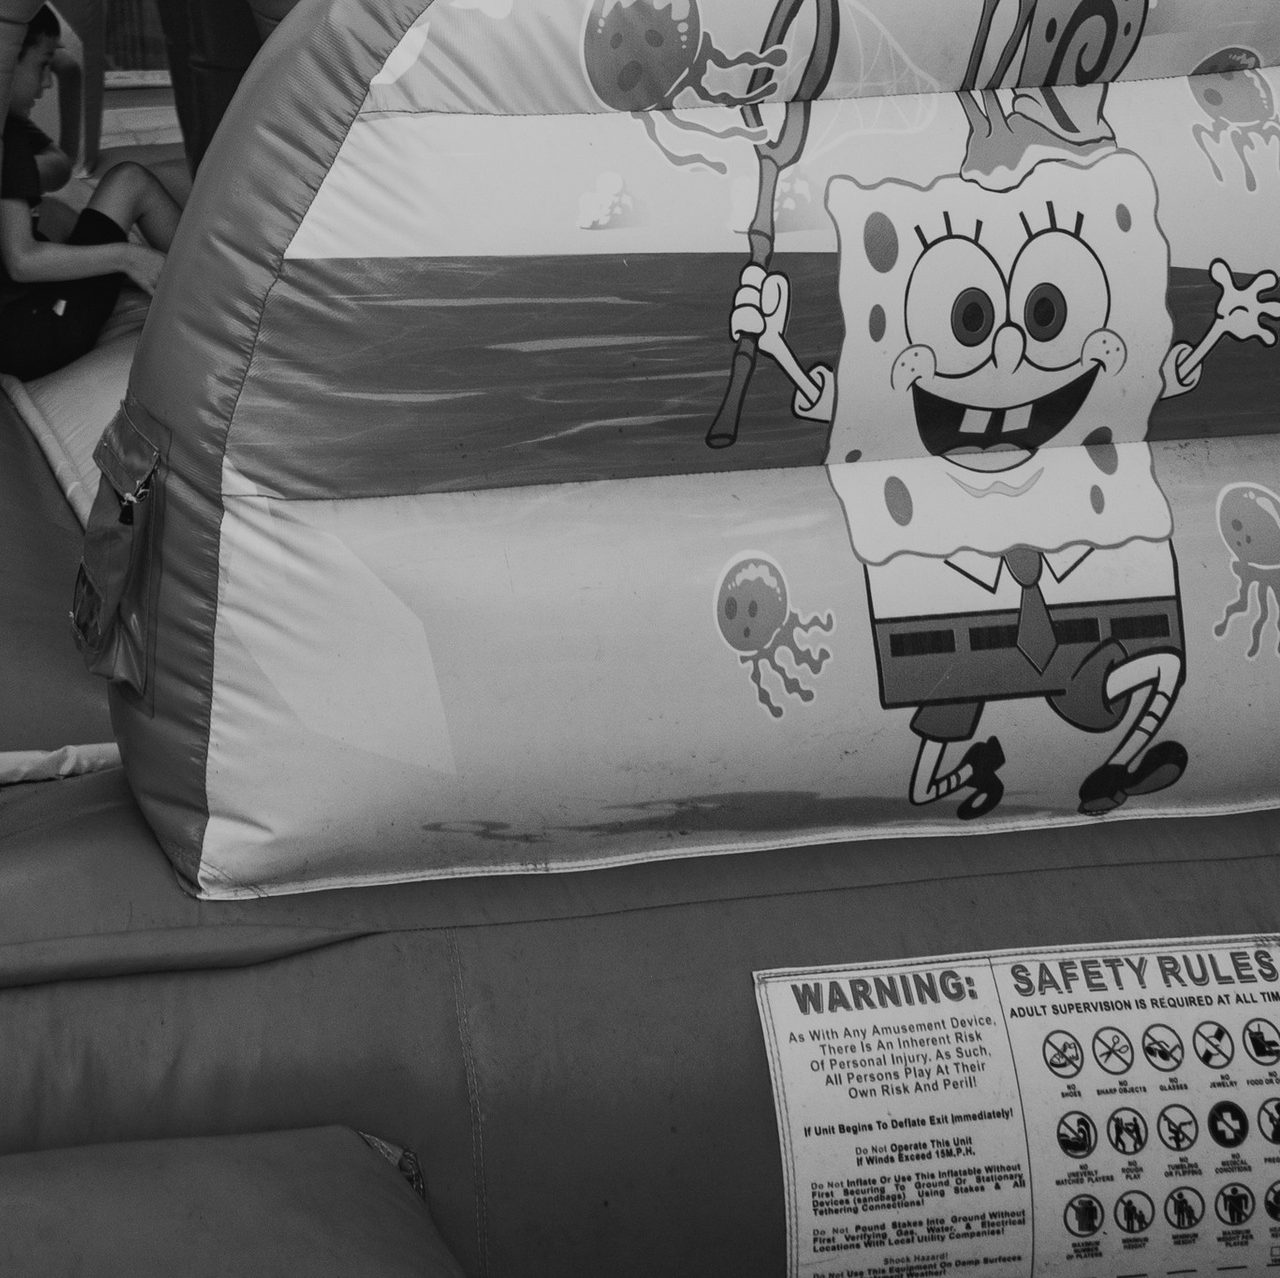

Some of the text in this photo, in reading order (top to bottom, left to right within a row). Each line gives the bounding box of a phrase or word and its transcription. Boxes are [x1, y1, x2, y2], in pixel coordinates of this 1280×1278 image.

[1010, 950, 1279, 996] SAFETY RULES
[791, 970, 978, 1015] WARNING:
[1010, 991, 1280, 1019] ADULT SUPERVISION IS REQUIRED AT ALL TIM
[789, 1032, 805, 1044] As
[809, 1029, 839, 1041] With
[843, 1026, 867, 1039] Any
[872, 1019, 946, 1036] Amusement
[820, 1031, 983, 1056] There Is An Inherent Risk
[810, 1059, 825, 1072] Of
[830, 1054, 887, 1070] Personal
[936, 1049, 951, 1060] As
[956, 1045, 991, 1058] Such,
[825, 1061, 986, 1086] All Persons Play At Their
[849, 1076, 977, 1099] Own Risk And Peril!
[804, 1108, 1013, 1137] If Unit Begins To Deflate Exit Immediately!
[855, 1137, 972, 1155] Do Not Operate This Unit
[857, 1157, 864, 1166] If
[866, 1154, 895, 1165] Winds
[898, 1151, 932, 1162] Exceed
[811, 1163, 1021, 1191] Do Not Inflate Or Use This Inflatable Without
[812, 1173, 1023, 1199] First Securing To Ground Or Stationary
[812, 1180, 1025, 1208] Devices (sandbags) Using Stakes & All
[813, 1199, 924, 1216] Tethering Connections!
[813, 1210, 1025, 1237] Do Not Pound Stakes Into Ground Without
[813, 1236, 835, 1245] First
[844, 1231, 887, 1243] Verifying
[981, 1218, 1025, 1229] Electrical
[813, 1228, 1004, 1253] Locations With Local Utility Companies!
[868, 1268, 886, 1276] This
[889, 1264, 937, 1275] Equipment
[940, 1261, 952, 1269] On
[955, 1259, 980, 1268] Damp
[983, 1255, 1022, 1265] Surfaces
[883, 1252, 948, 1266] Shock Hazard!
